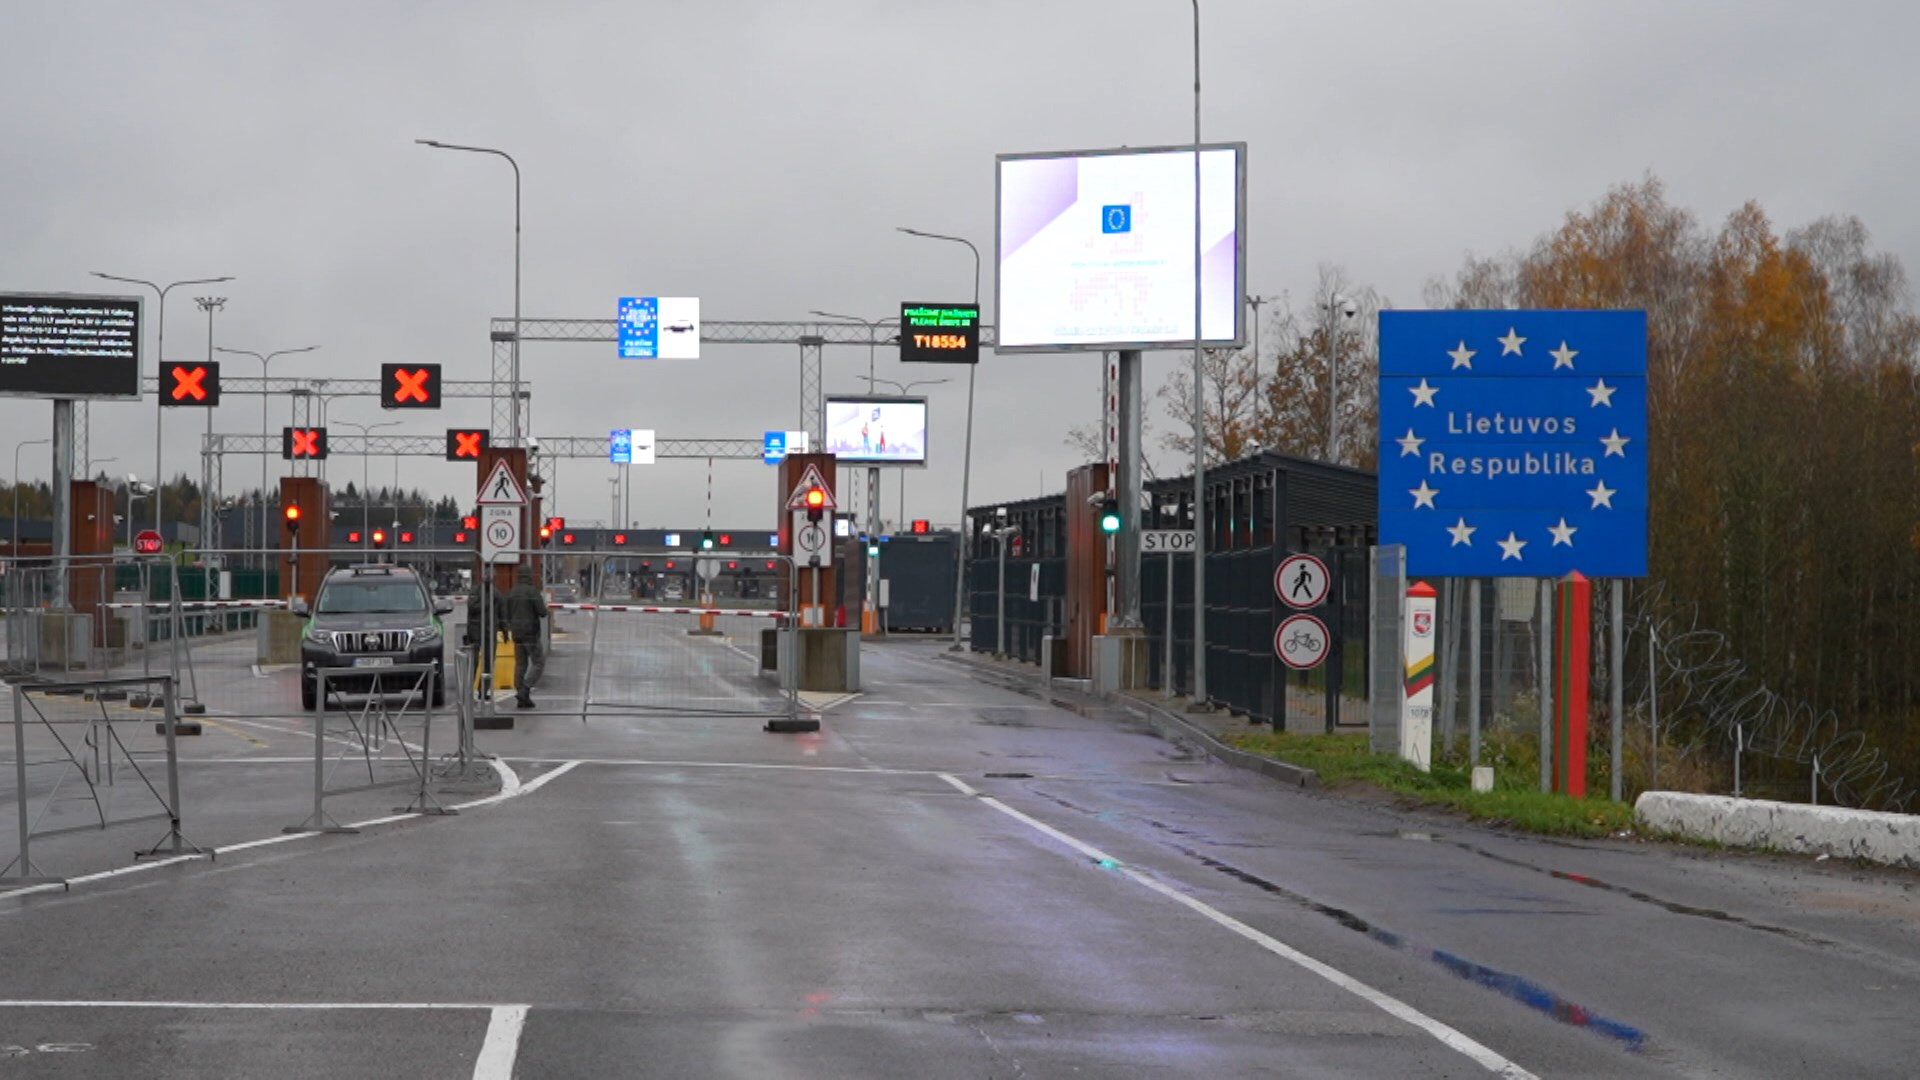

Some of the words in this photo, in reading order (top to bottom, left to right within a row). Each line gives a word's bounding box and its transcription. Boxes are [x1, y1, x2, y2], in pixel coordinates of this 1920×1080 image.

[913, 334, 967, 349] T18554
[1447, 411, 1577, 435] Lietuvos
[1428, 452, 1596, 480] Respublika
[495, 528, 507, 540] 10
[1144, 532, 1196, 550] STOP
[136, 538, 162, 551] STOP
